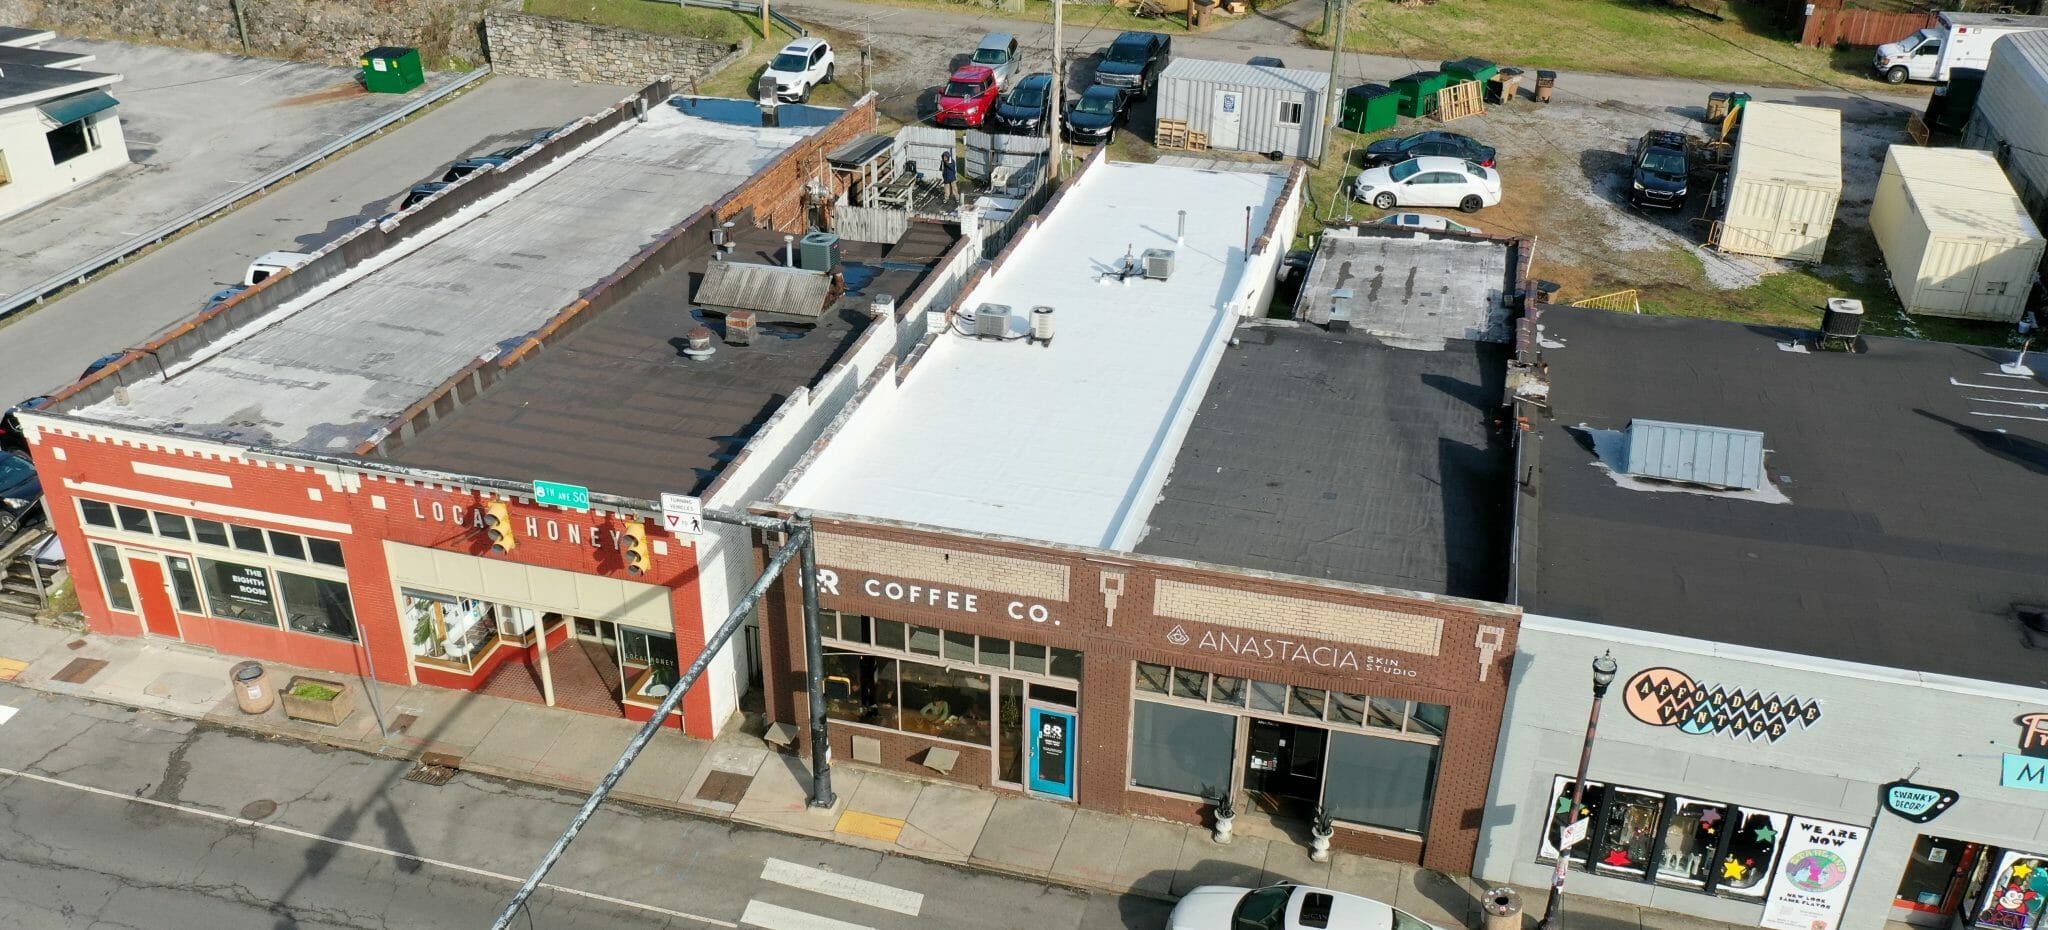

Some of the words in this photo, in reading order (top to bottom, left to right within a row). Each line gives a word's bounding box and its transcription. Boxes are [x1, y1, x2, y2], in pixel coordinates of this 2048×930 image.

[537, 486, 555, 498] 8TH
[573, 491, 587, 504] SO
[413, 498, 485, 529] LOCA
[525, 517, 621, 551] HONEY
[232, 575, 265, 587] EIGHTH
[244, 568, 263, 577] THE
[239, 585, 267, 596] ROOM
[865, 579, 978, 613] COFFEE
[1008, 601, 1061, 625] CO.
[1199, 630, 1358, 671] ANASTACIA
[1366, 656, 1398, 666] SKIN
[1366, 664, 1416, 677] STUDIO
[1641, 682, 1817, 721] AFFORDABLE
[1664, 706, 1782, 736] VINTAGE
[2016, 763, 2048, 784] M
[1894, 790, 1937, 803] SWANKY
[1800, 823, 1823, 834] WE
[1828, 829, 1857, 840] ARE
[1809, 835, 1846, 847] NOW
